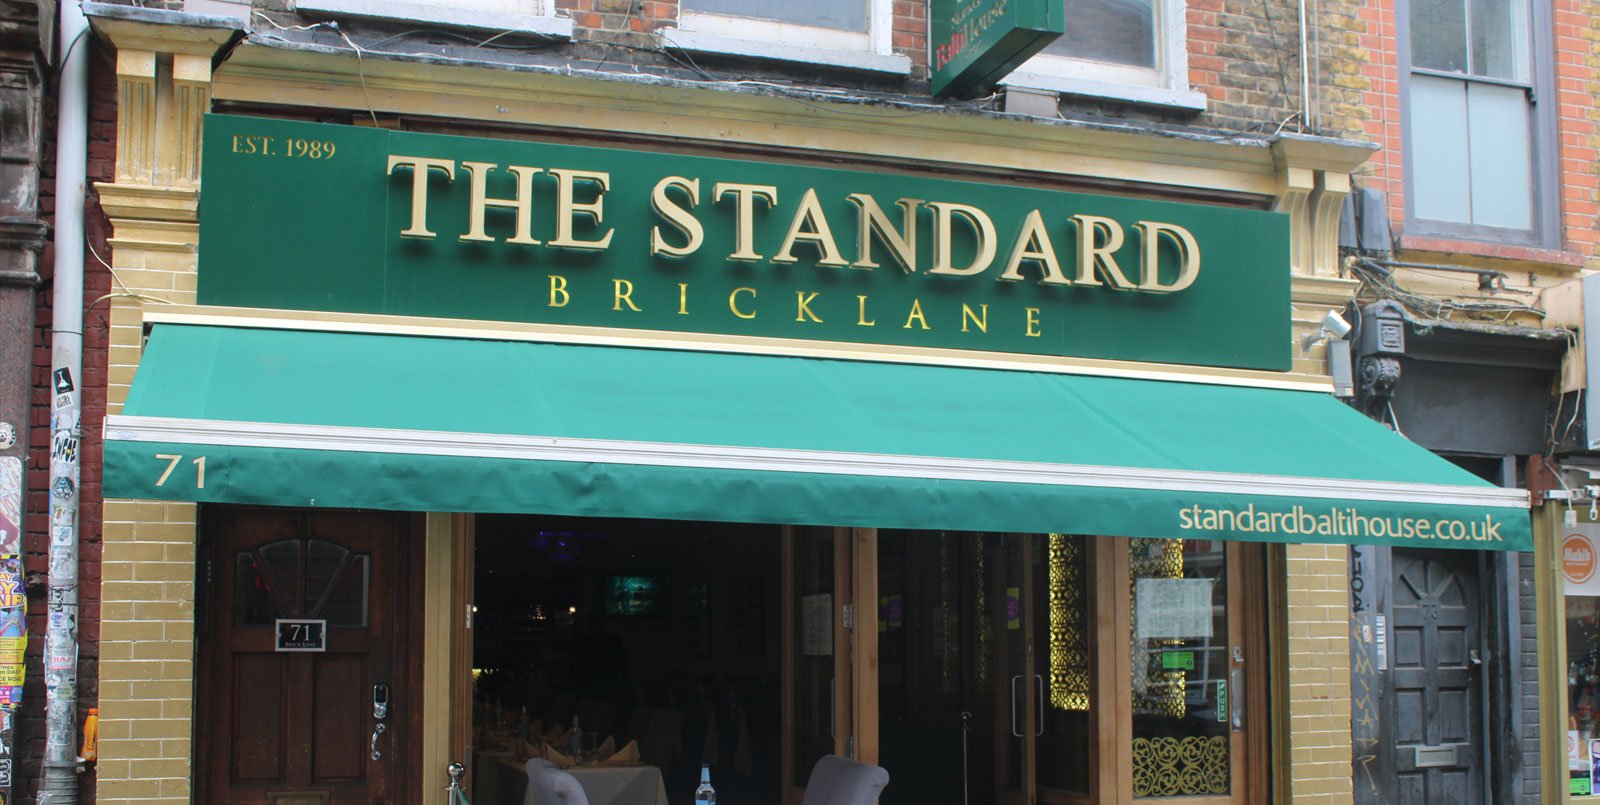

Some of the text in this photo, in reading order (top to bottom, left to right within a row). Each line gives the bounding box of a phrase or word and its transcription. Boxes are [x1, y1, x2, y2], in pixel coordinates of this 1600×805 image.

[232, 135, 336, 160] EST. 1989
[387, 155, 1202, 294] THE STANDARD
[155, 453, 206, 489] 71
[1178, 503, 1503, 542] standardbaltihouse.co.uk
[290, 624, 311, 641] 71
